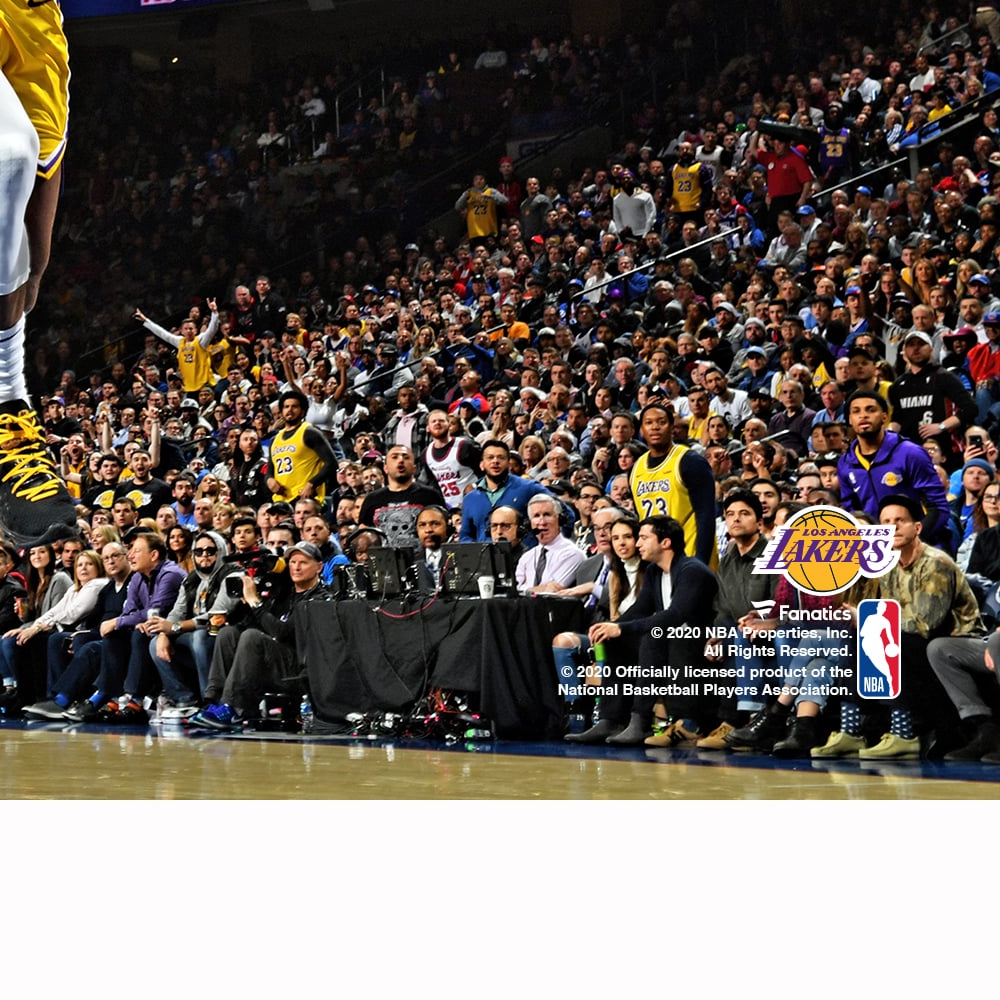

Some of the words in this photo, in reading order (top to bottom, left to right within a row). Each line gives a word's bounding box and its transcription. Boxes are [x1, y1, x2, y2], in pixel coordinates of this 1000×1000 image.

[276, 456, 294, 476] 23
[441, 481, 461, 497] 25
[636, 479, 671, 497] LAKERS
[641, 497, 668, 517] 23
